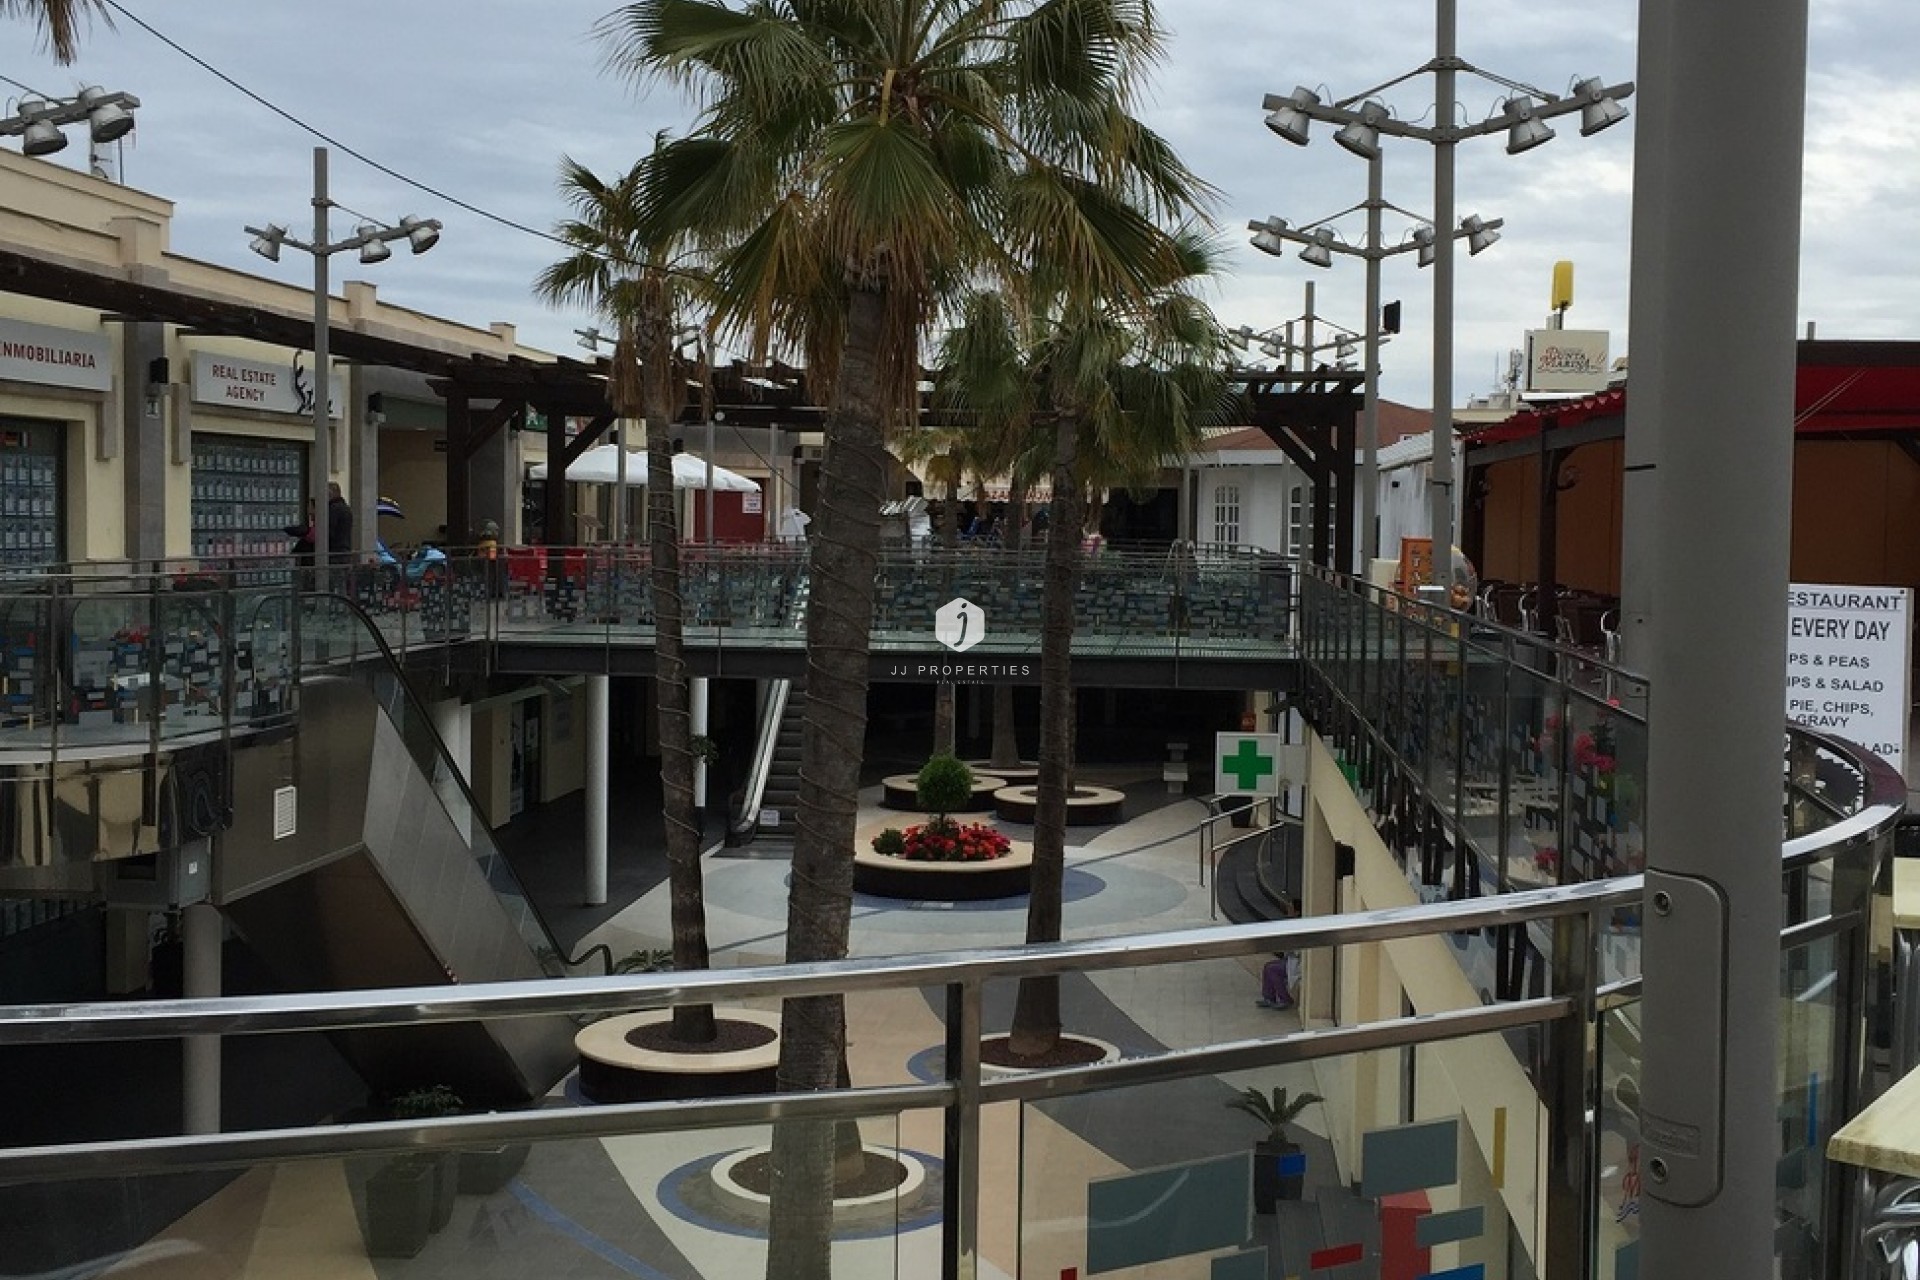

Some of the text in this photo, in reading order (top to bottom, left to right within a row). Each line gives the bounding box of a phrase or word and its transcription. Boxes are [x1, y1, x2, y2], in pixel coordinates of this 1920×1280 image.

[212, 364, 277, 386] REAL ESTATE
[225, 385, 265, 402] AGENCY
[1791, 616, 1891, 641] EVERY DAY
[1813, 654, 1824, 667] &
[1828, 655, 1870, 669] PEAS
[1815, 677, 1826, 690] &
[1831, 678, 1884, 693] SALAD
[1822, 701, 1874, 717] CHIPS,
[1795, 713, 1850, 728] GRAVY
